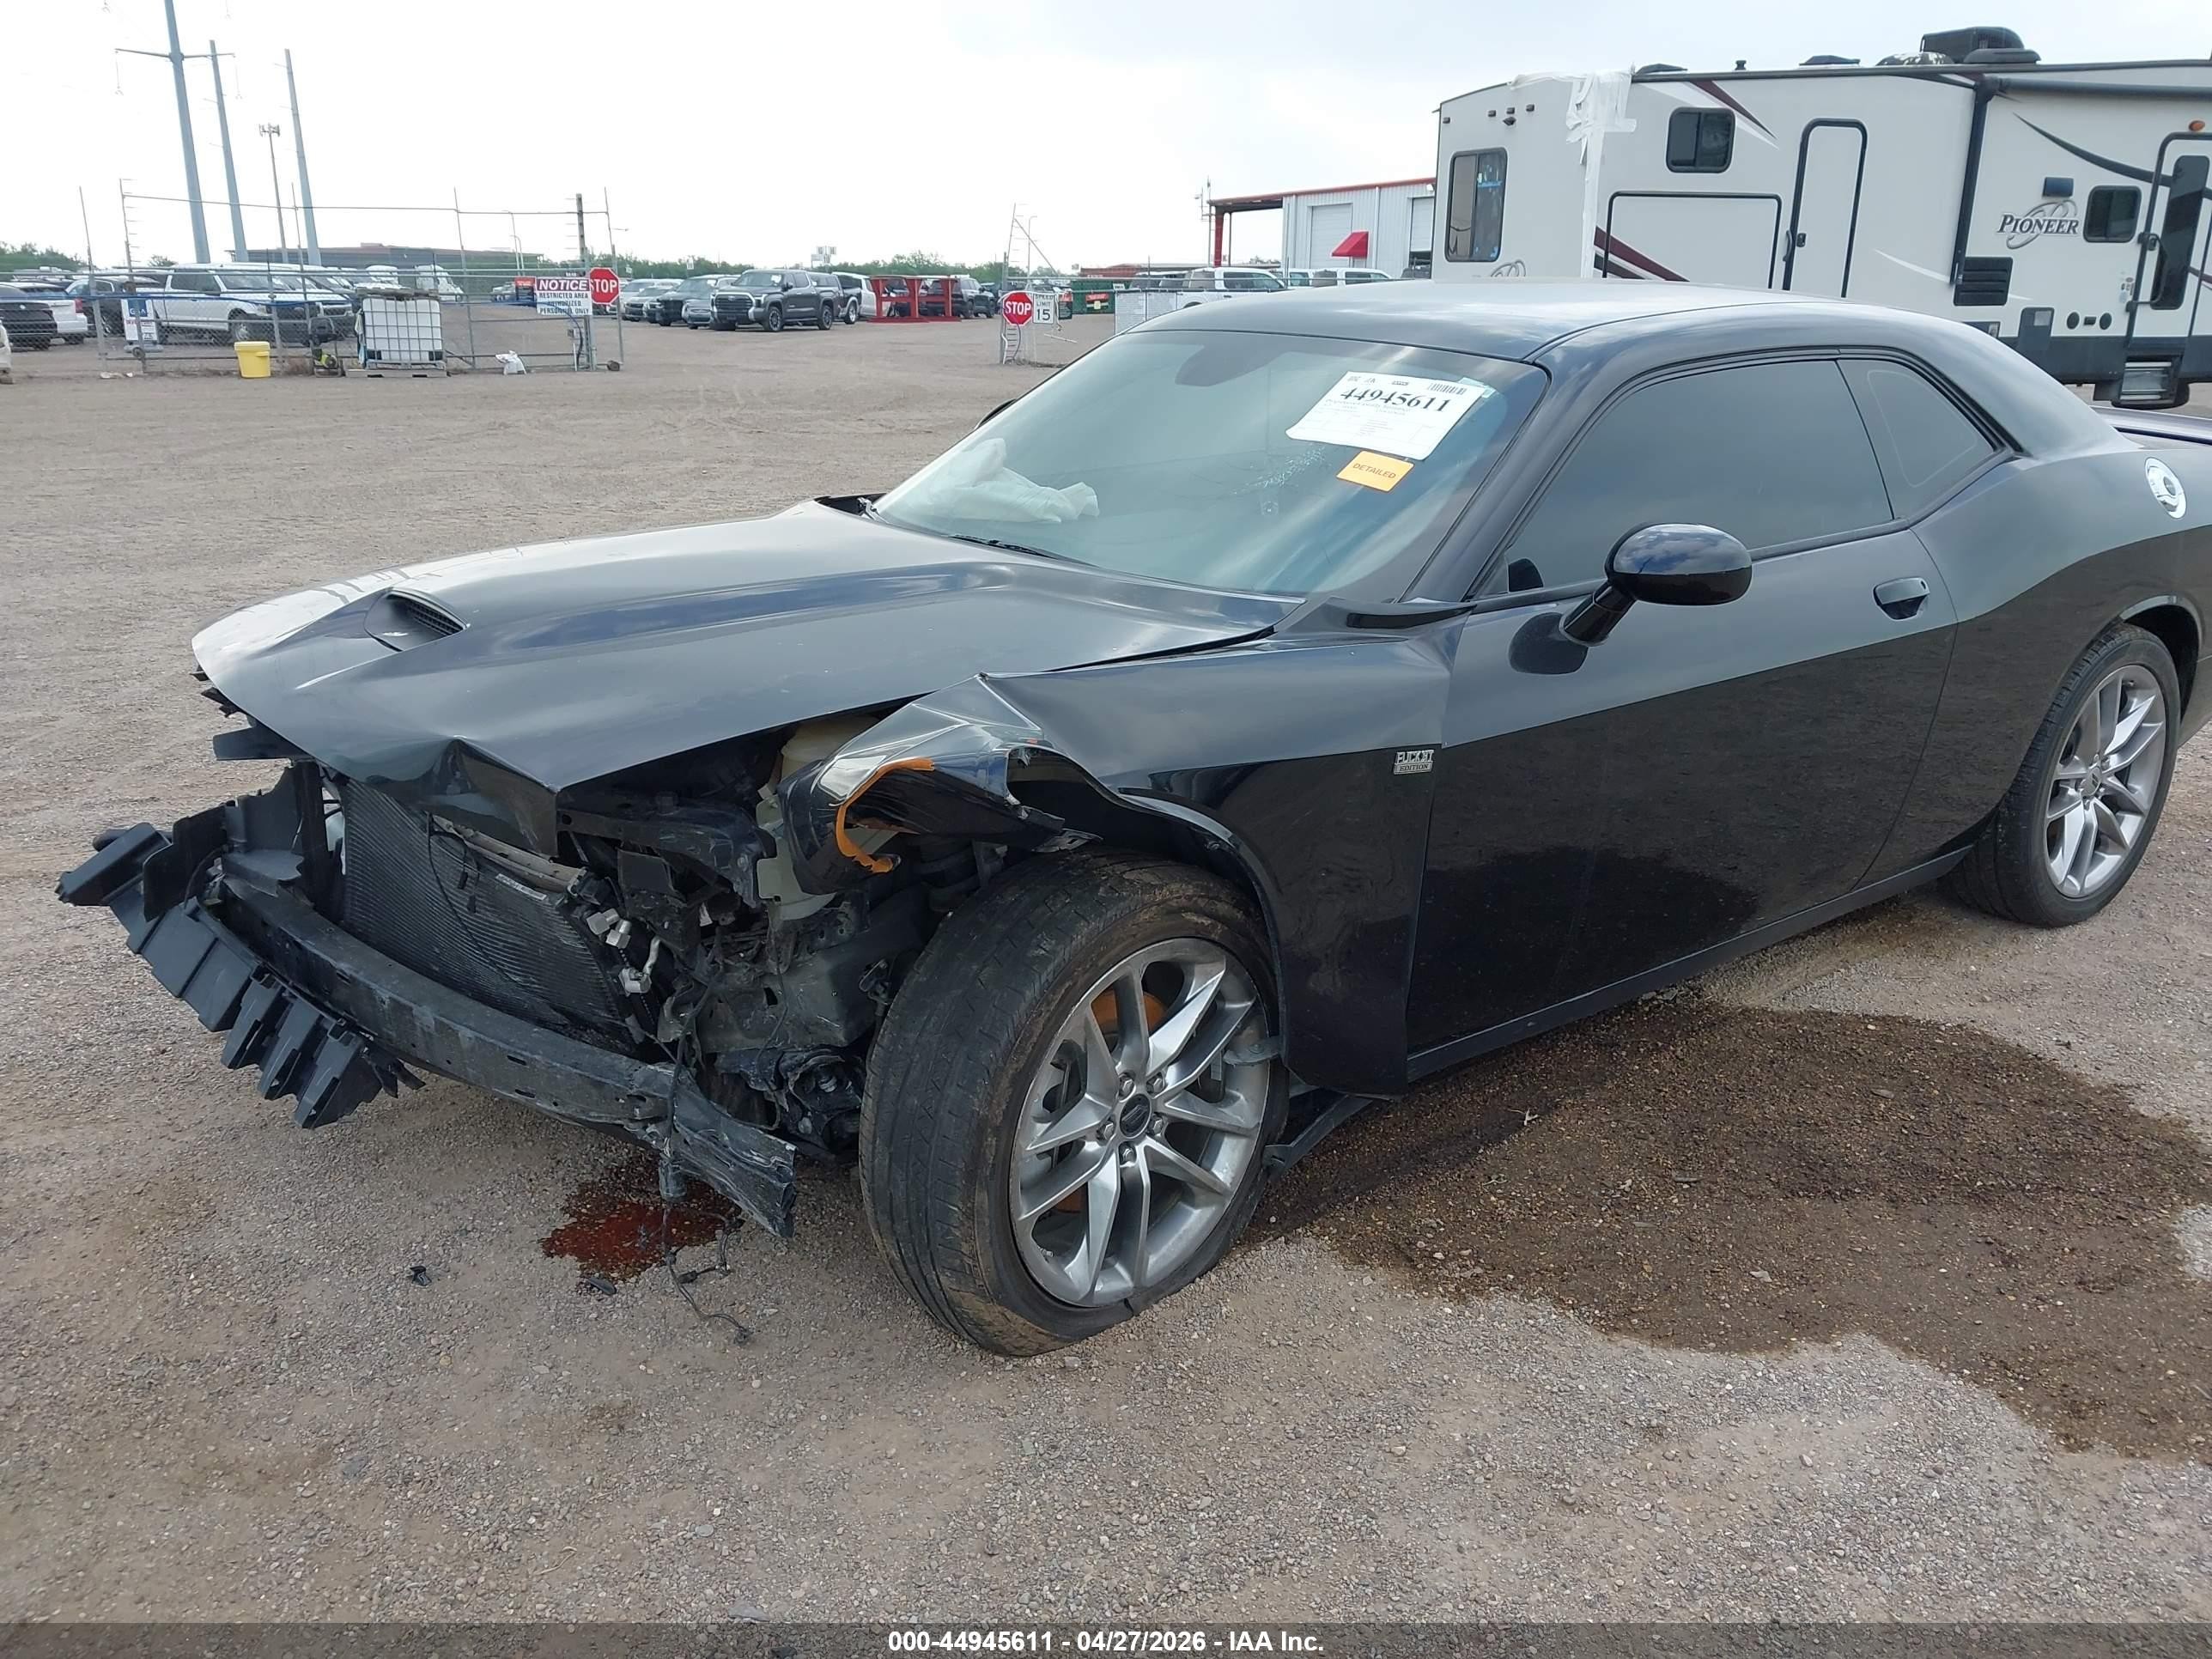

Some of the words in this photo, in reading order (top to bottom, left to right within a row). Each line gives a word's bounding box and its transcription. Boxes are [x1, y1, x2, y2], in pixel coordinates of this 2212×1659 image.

[1996, 214, 2079, 234] PIONEER
[538, 279, 588, 291] NOTICE
[1005, 301, 1031, 315] STOP
[1036, 308, 1050, 321] 15
[1340, 386, 1451, 412] 44945611
[1352, 462, 1396, 480] DETAILED
